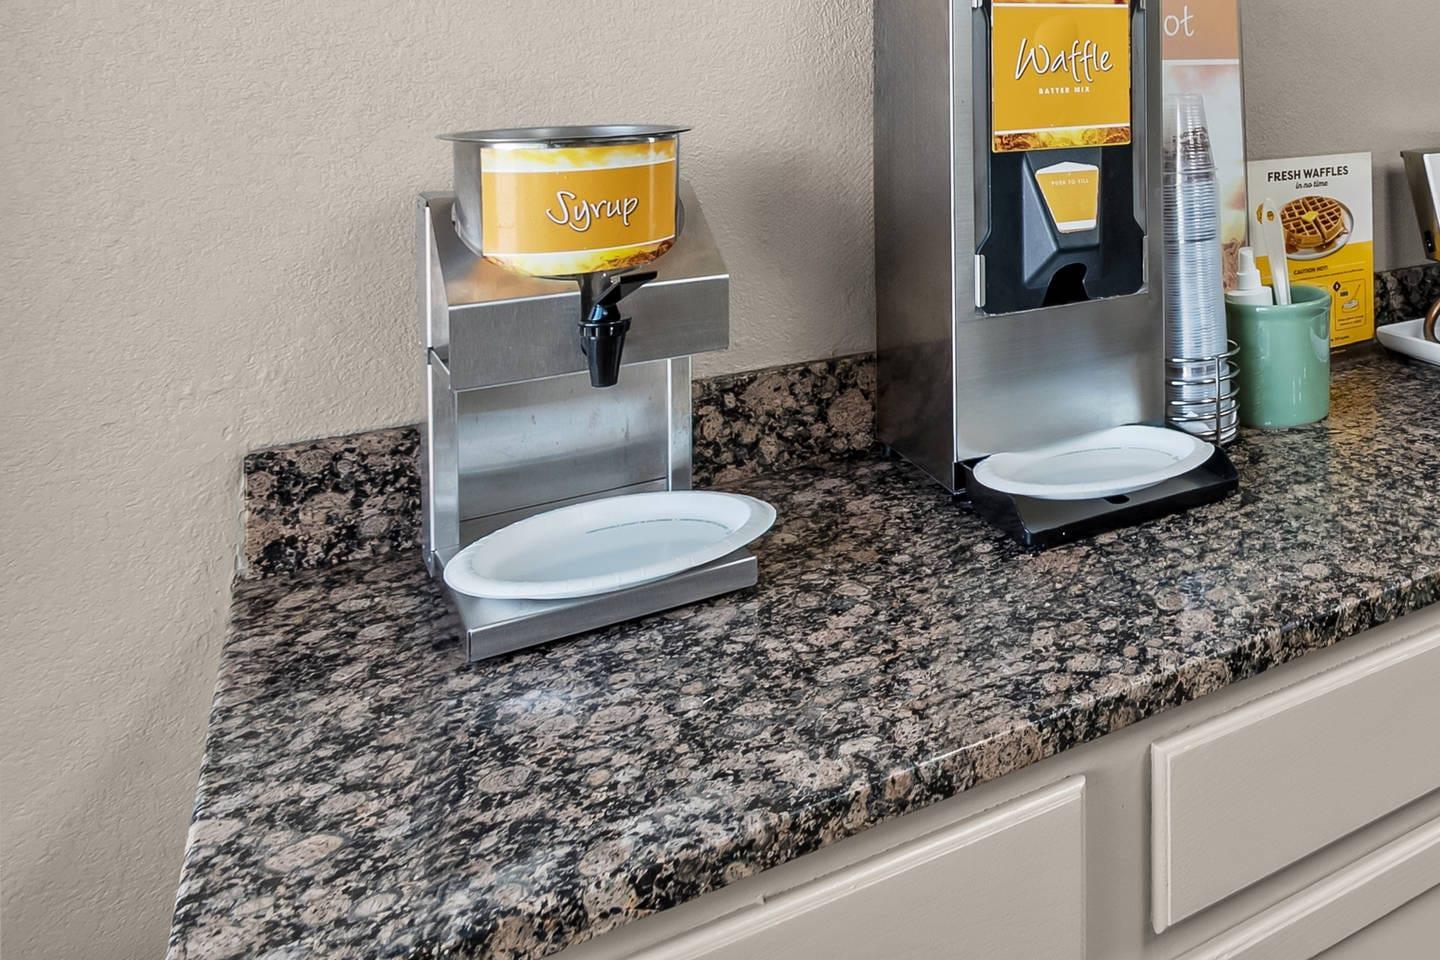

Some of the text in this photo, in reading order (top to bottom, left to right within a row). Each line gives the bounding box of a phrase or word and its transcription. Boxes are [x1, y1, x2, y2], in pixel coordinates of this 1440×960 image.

[1163, 5, 1195, 37] ot
[1015, 38, 1113, 83] Waffle
[1038, 87, 1070, 95] BATTER
[1267, 165, 1349, 182] FRESH WAFFLES
[1295, 181, 1303, 189] in
[1313, 180, 1328, 188] time
[545, 190, 639, 232] Syrup
